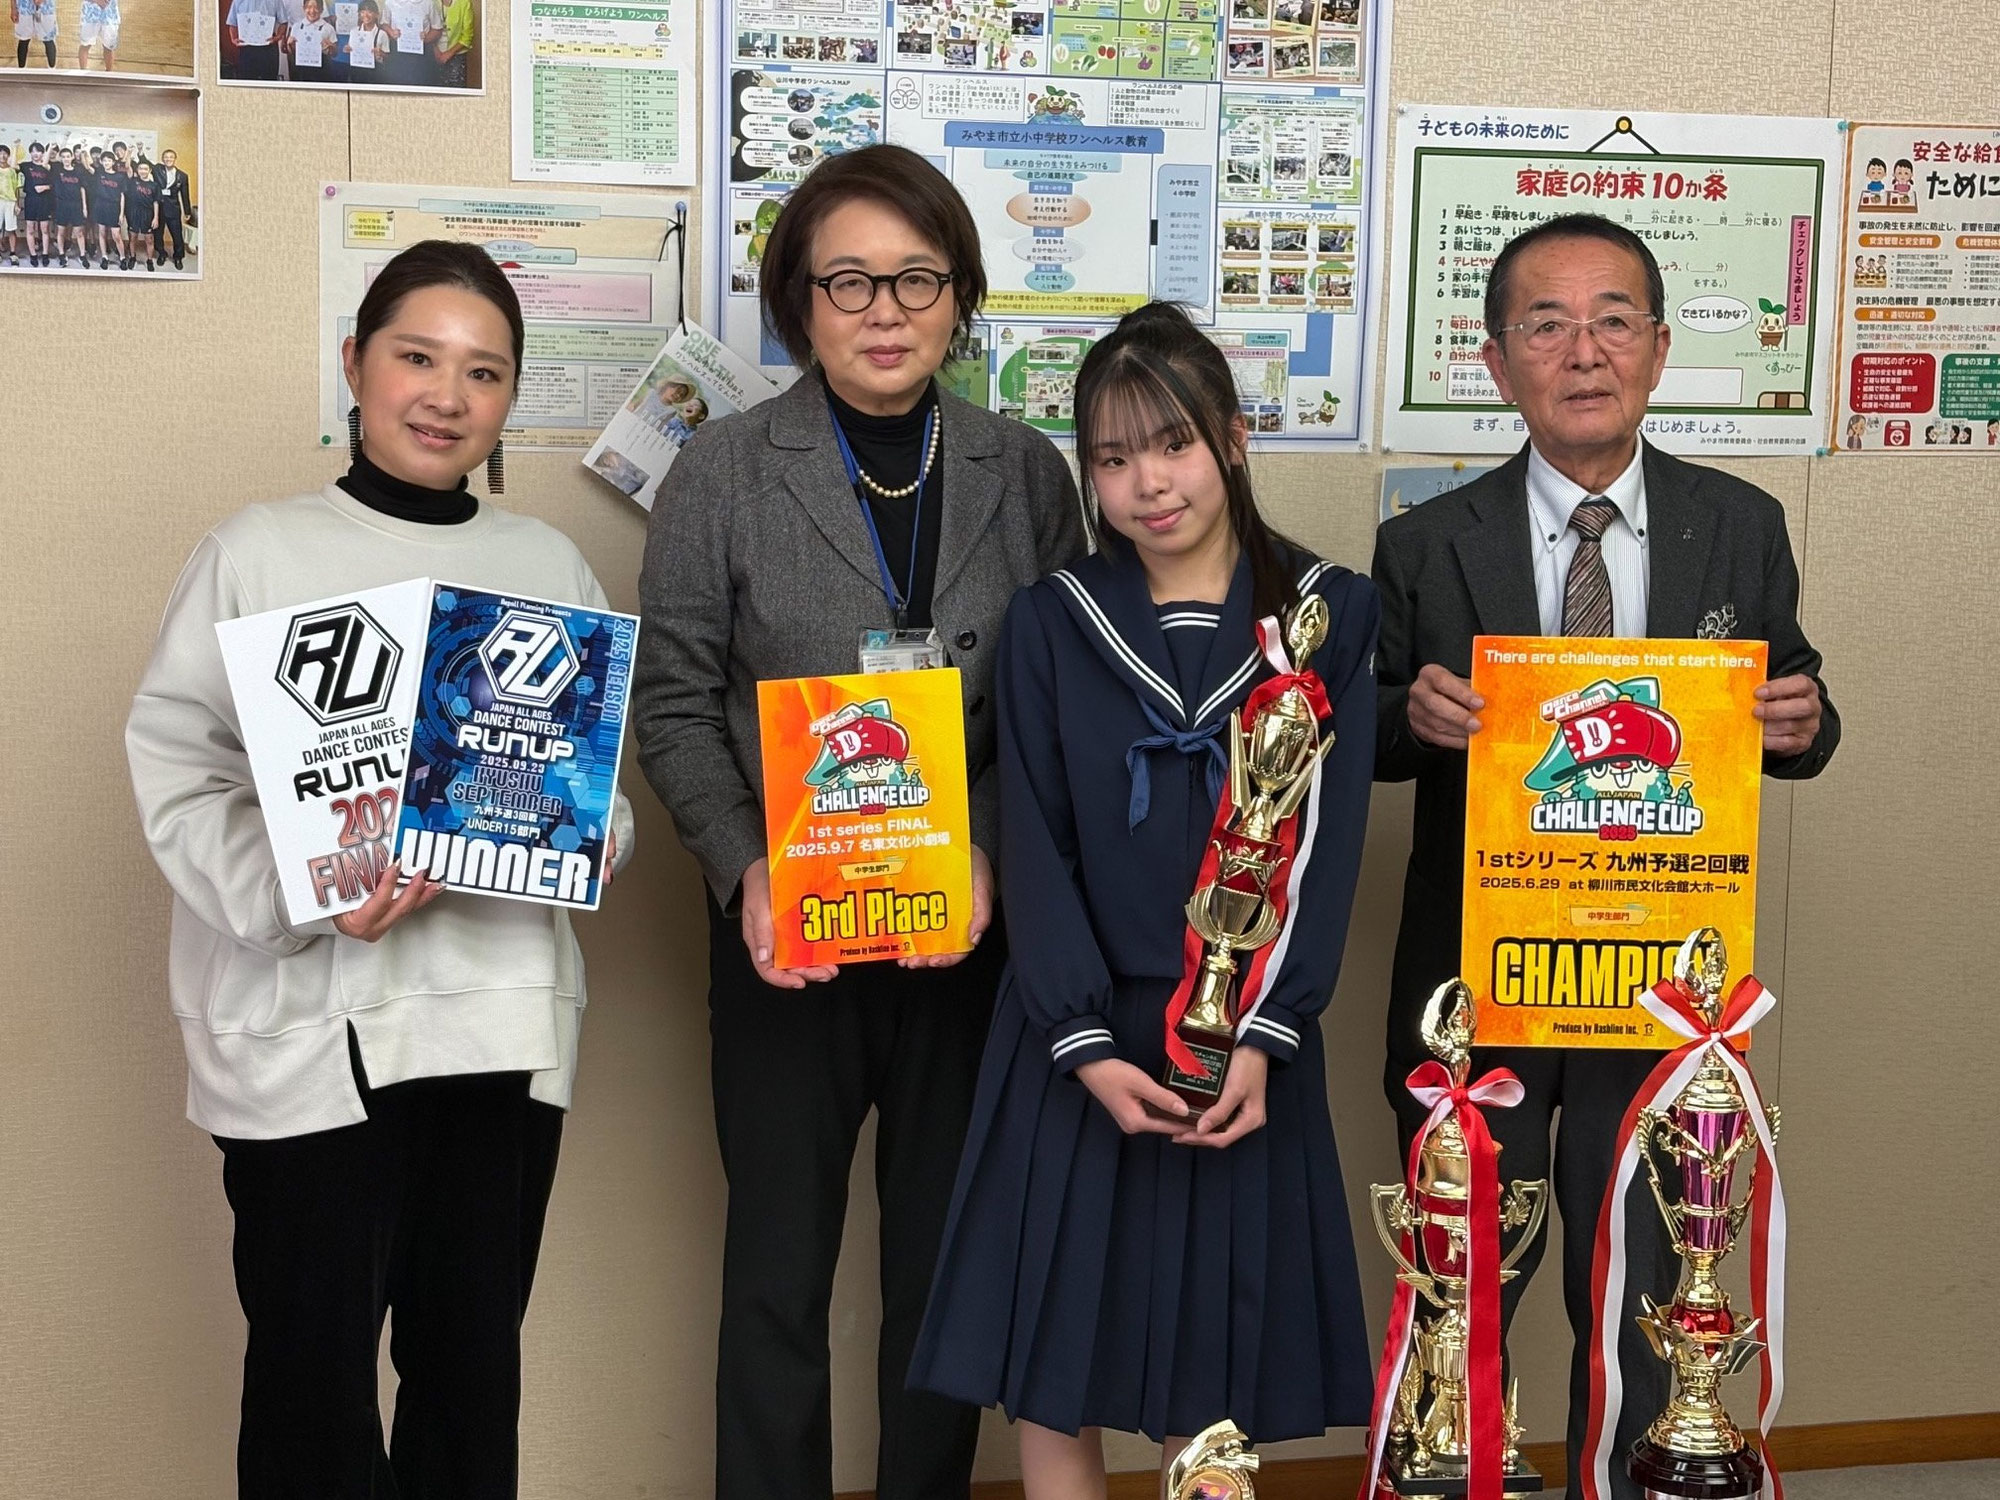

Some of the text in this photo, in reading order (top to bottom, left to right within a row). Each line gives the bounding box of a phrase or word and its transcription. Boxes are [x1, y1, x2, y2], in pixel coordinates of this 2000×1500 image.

[534, 7, 668, 21] つながろう ひろげよう ワンヘルス
[961, 129, 1148, 147] みやま市立小中学校ワンヘルス教育
[1418, 119, 1569, 139] 子どもの未来のために
[1003, 159, 1108, 170] 未来の自分の生き方をみつける
[1926, 171, 2000, 200] ために
[1442, 209, 1447, 219] 1
[1440, 225, 1447, 235] 2
[1439, 241, 1446, 250] 3
[1438, 256, 1445, 266] 4
[1437, 272, 1445, 282] 5
[1793, 220, 1807, 322] チェックしてみましょう
[1437, 288, 1445, 298] 6
[1681, 308, 1748, 319] できているかな？
[1436, 319, 1486, 330] 7 毎日10
[690, 330, 722, 357] ONE
[1435, 335, 1442, 345] 8
[1434, 350, 1442, 360] 9
[1429, 371, 1441, 382] 10
[1473, 417, 1529, 432] まず、自
[610, 619, 634, 661] 2025
[1485, 649, 1757, 668] There are challenges that start here.
[490, 703, 553, 721] JAPAN ALL AGES
[319, 716, 396, 745] JAPAN ALL AGES
[473, 710, 566, 737] DANCE CONTEST
[302, 726, 409, 766] DANCE CONTES
[457, 723, 574, 762] RUNUP
[480, 754, 545, 774] 2025.09.23
[473, 765, 544, 793] KYUSHU
[452, 782, 563, 816] SEPTEMBER
[813, 786, 928, 813] CHALLENGE CUP
[474, 804, 538, 823] 九州予選3回戦
[1533, 800, 1700, 833] CHALLENGE CUP
[467, 817, 541, 840] UNDER15部門
[808, 817, 932, 838] 1st series FINAL
[1599, 825, 1638, 840] 2025
[786, 831, 950, 858] 2025.9.7 名東文化小劇場
[401, 827, 592, 902] WINNER
[854, 864, 890, 874] 中学生部門
[1476, 850, 1750, 874] 1stシリーズ 九州予選2回戦
[1480, 877, 1740, 894] 2025.6.29 at 柳川市民文化会館大ホール
[802, 889, 947, 942] 3rd Place
[1587, 911, 1630, 921] 中学生部門
[1494, 938, 1711, 1008] CHAMPI
[1553, 1022, 1582, 1034] Produce
[1584, 1023, 1592, 1036] by
[1625, 1024, 1639, 1035] Inc.
